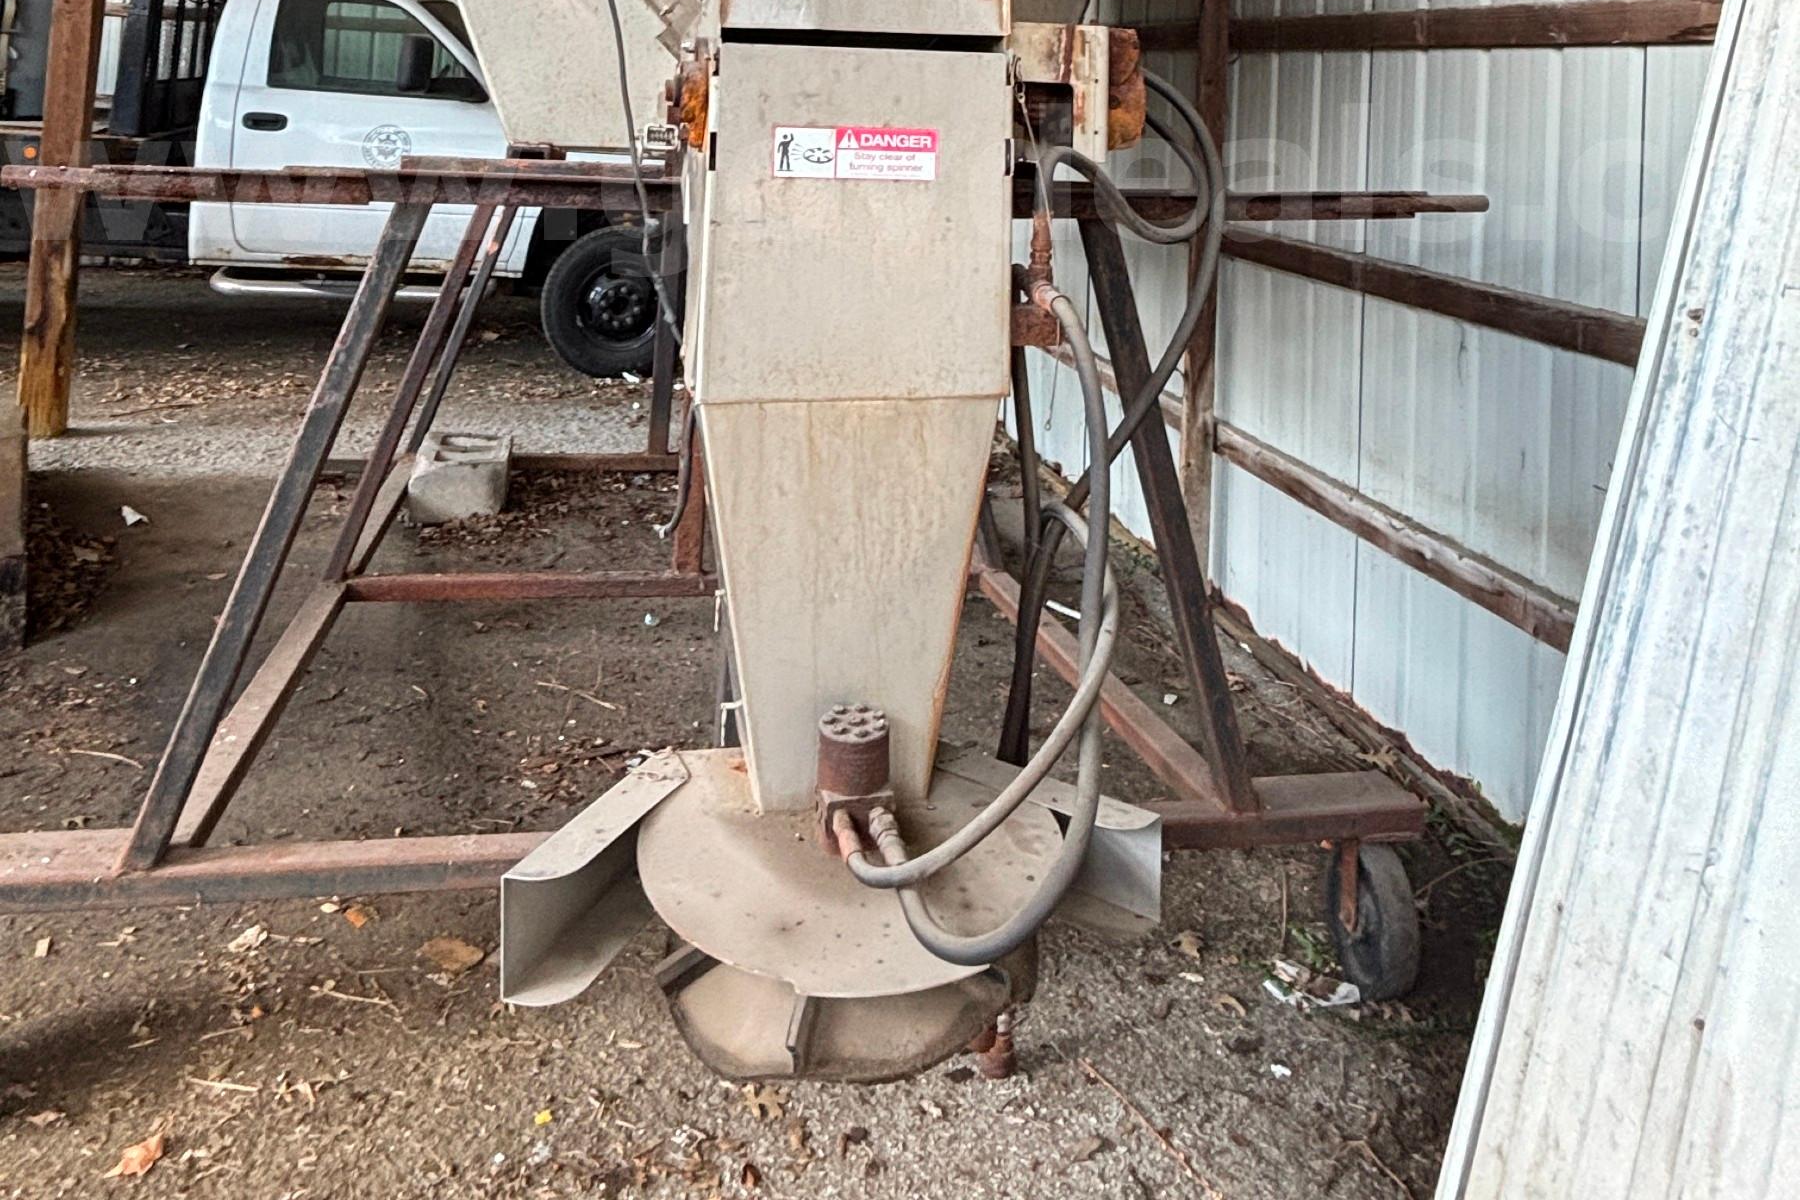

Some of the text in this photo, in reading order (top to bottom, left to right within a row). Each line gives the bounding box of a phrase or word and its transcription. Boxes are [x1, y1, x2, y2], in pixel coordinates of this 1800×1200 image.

[860, 133, 932, 148] DANGER
[854, 151, 916, 161] Stay clear of
[849, 161, 924, 173] turning spinner
